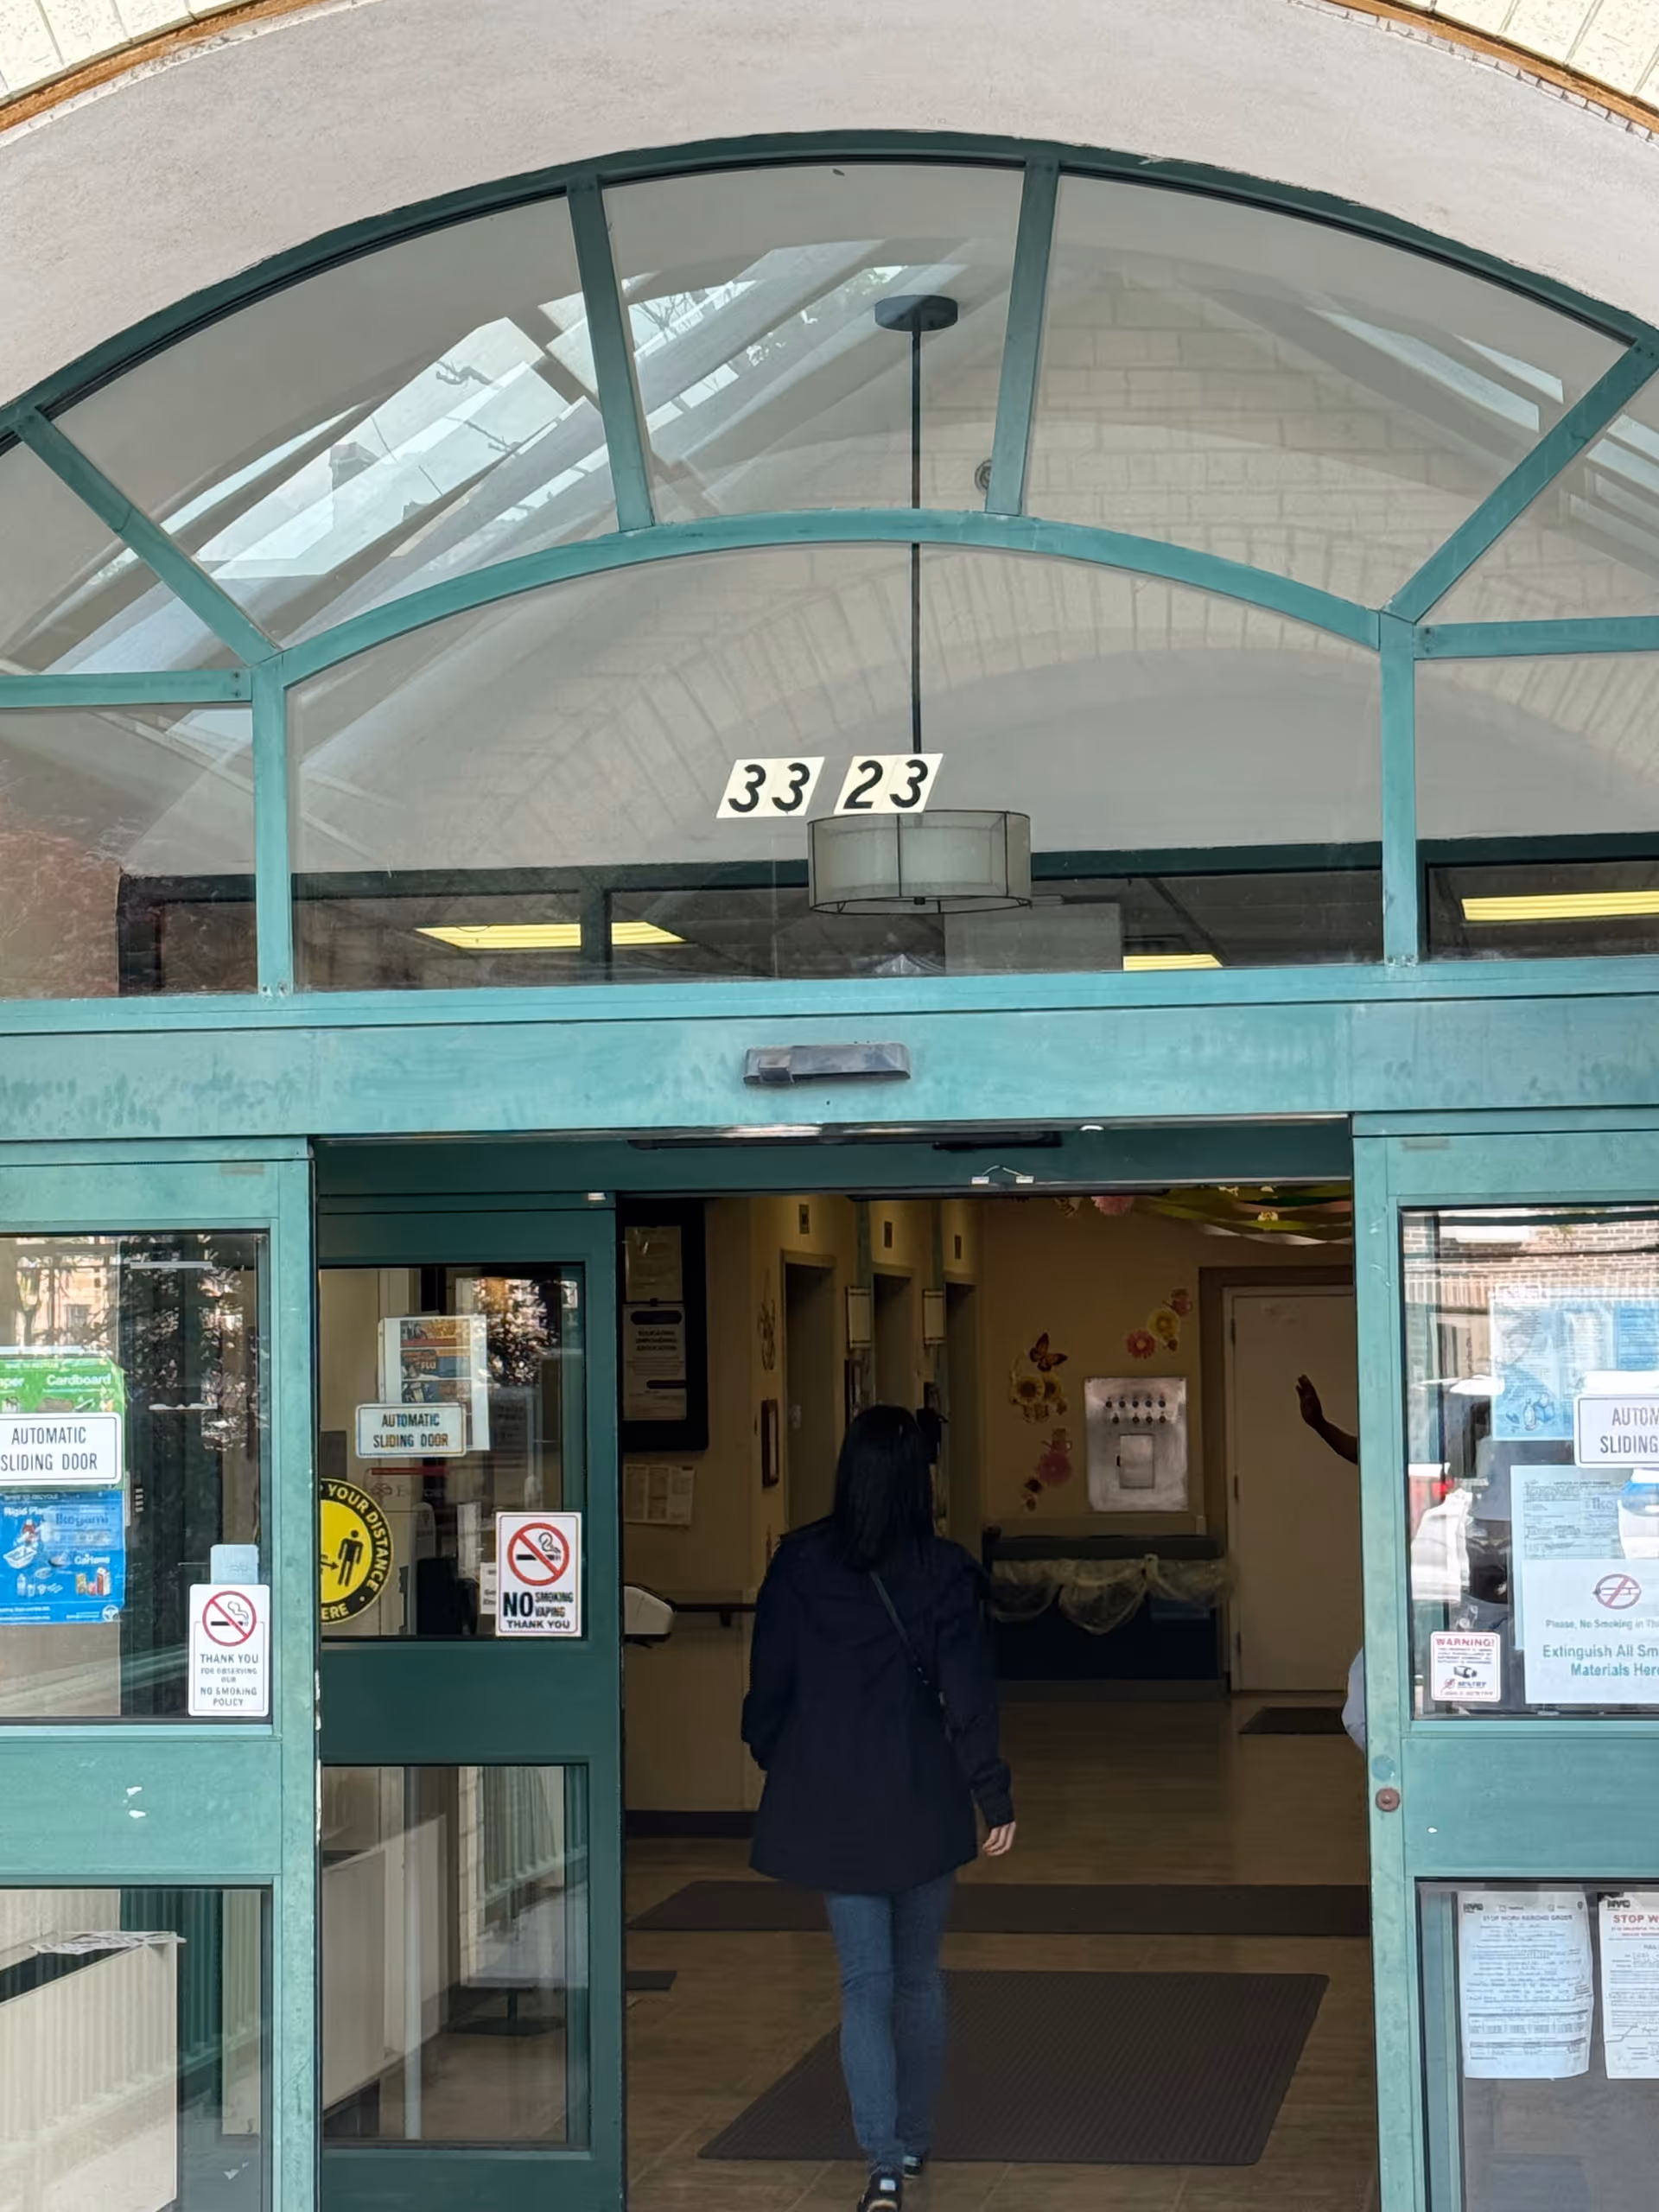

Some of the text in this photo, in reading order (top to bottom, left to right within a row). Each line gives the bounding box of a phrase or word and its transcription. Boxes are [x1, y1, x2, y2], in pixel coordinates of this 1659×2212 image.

[728, 760, 929, 812] 33 23
[47, 1374, 111, 1386] Cardboard
[382, 1414, 441, 1427] AUTOMATIC
[1611, 1408, 1659, 1426] AUTOM
[11, 1427, 86, 1445] AUTOMATIC
[373, 1433, 448, 1448] SLIDING DOOR
[1600, 1435, 1658, 1454] SLIDING
[0, 1452, 98, 1471] SLIDING DOOR
[327, 1483, 390, 1592] YOUR DISTANCE
[503, 1592, 534, 1618] NO
[535, 1592, 574, 1603] SMOKING
[536, 1606, 566, 1618] VAPING
[506, 1620, 570, 1629] THANK YOU
[1580, 1618, 1592, 1629] No
[1594, 1618, 1633, 1630] Smoking
[1635, 1619, 1644, 1628] in
[1436, 1638, 1496, 1647] WARNING!
[200, 1653, 259, 1663] THANK YOU
[1542, 1644, 1613, 1661] Extinguish
[1616, 1644, 1634, 1658] All
[1571, 1662, 1630, 1677] Materials
[200, 1687, 257, 1695] NO SMOKING
[213, 1698, 244, 1707] POLICY
[1613, 1914, 1644, 1923] STOP
